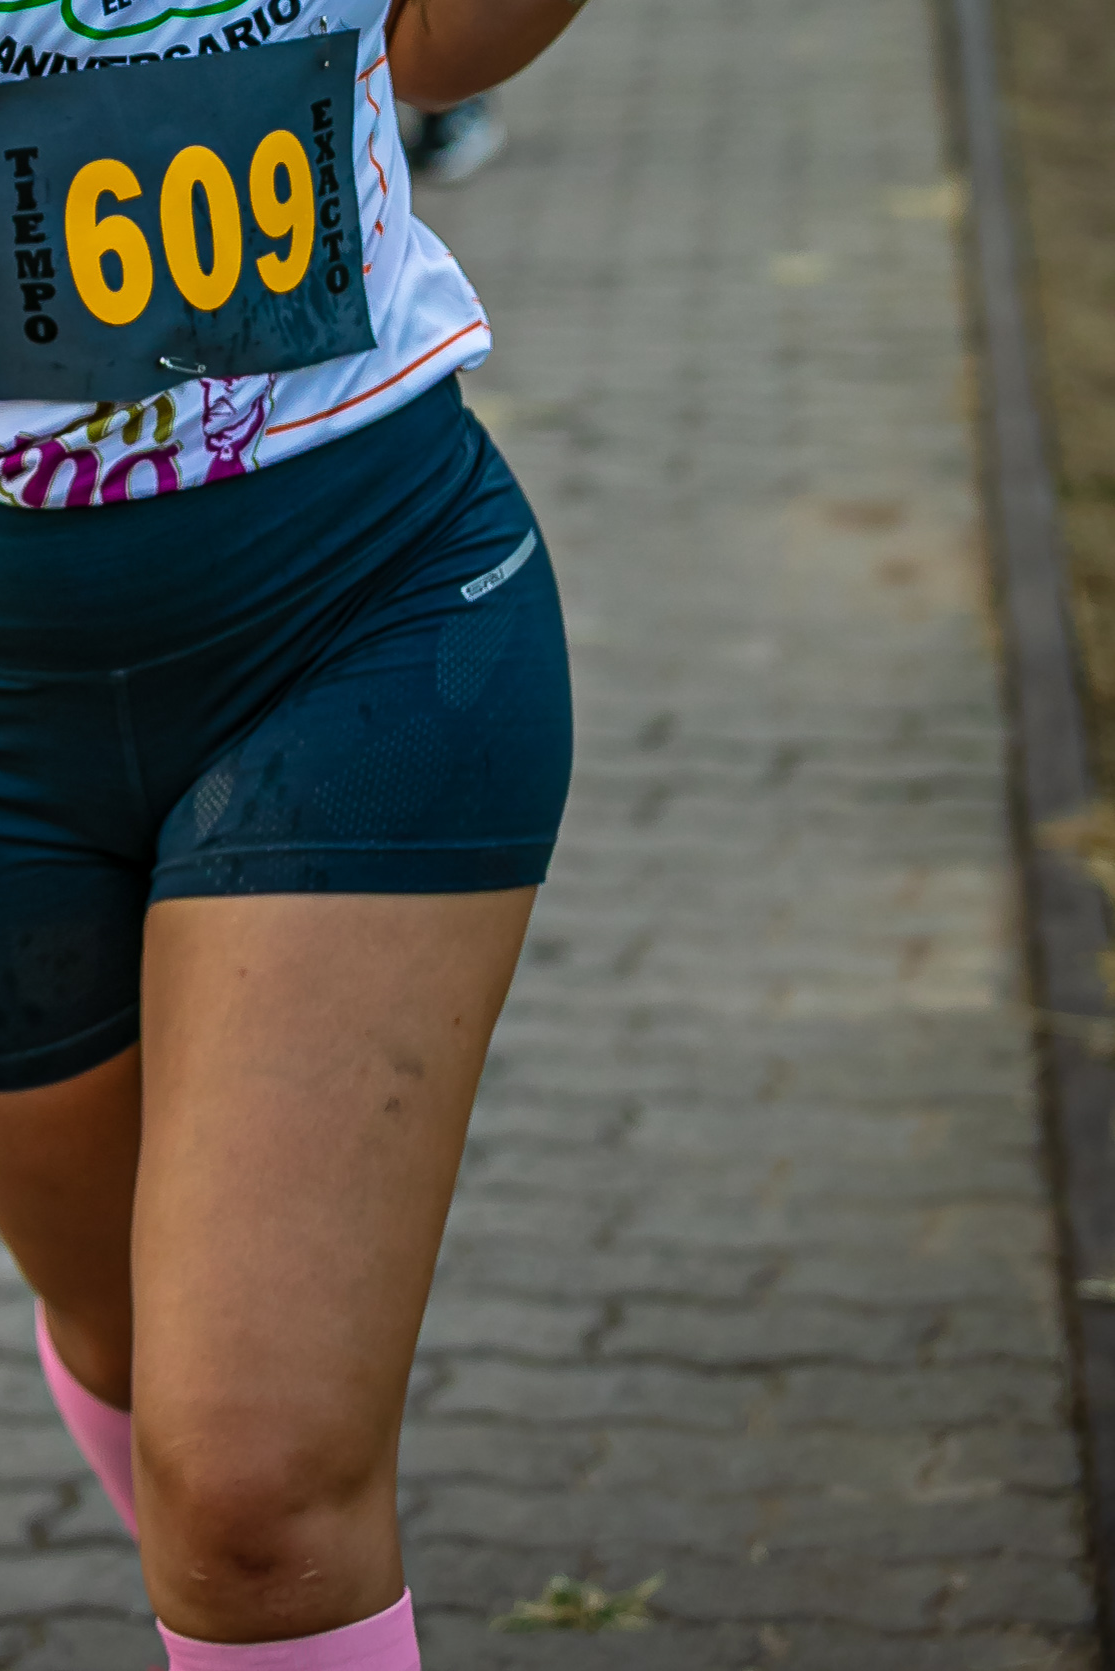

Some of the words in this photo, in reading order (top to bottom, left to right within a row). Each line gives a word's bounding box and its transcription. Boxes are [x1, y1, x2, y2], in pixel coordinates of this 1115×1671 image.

[4, 146, 59, 344] TIEMPO
[64, 129, 315, 326] 609
[310, 98, 350, 294] EXACTO
